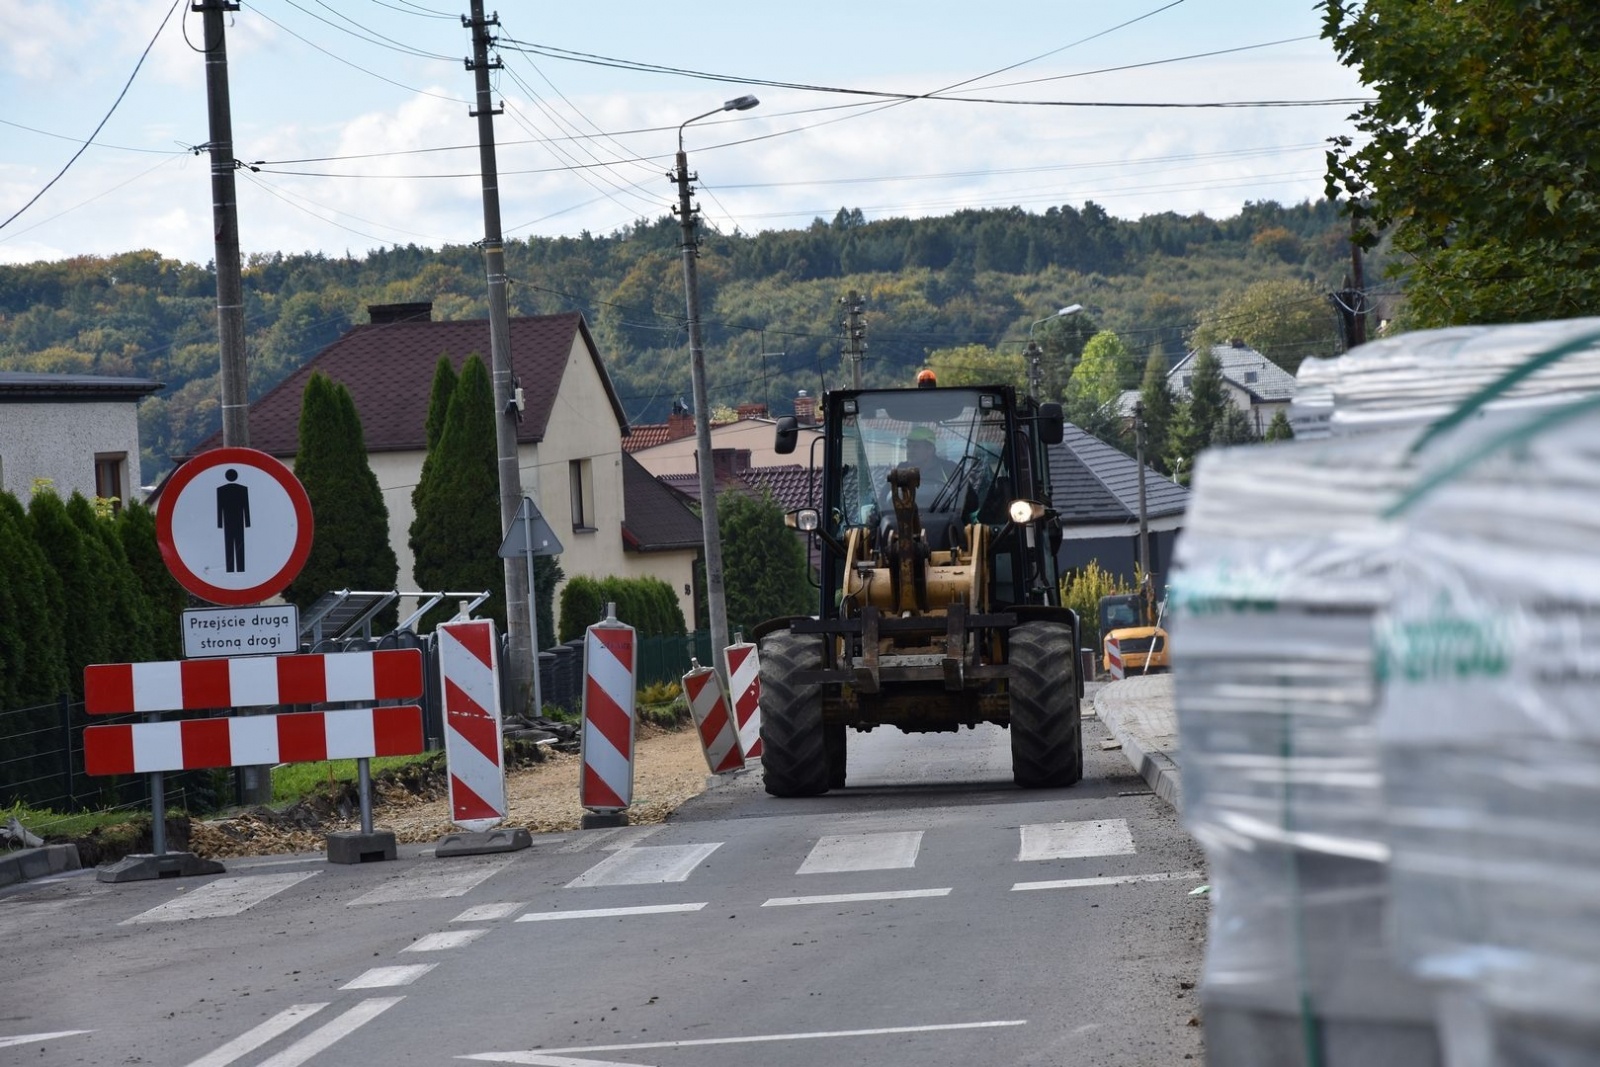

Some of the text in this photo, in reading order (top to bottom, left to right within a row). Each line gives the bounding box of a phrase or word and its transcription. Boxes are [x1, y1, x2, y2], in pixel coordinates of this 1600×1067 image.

[190, 614, 289, 631] Przejście drugą
[201, 633, 281, 650] stroną drogi
